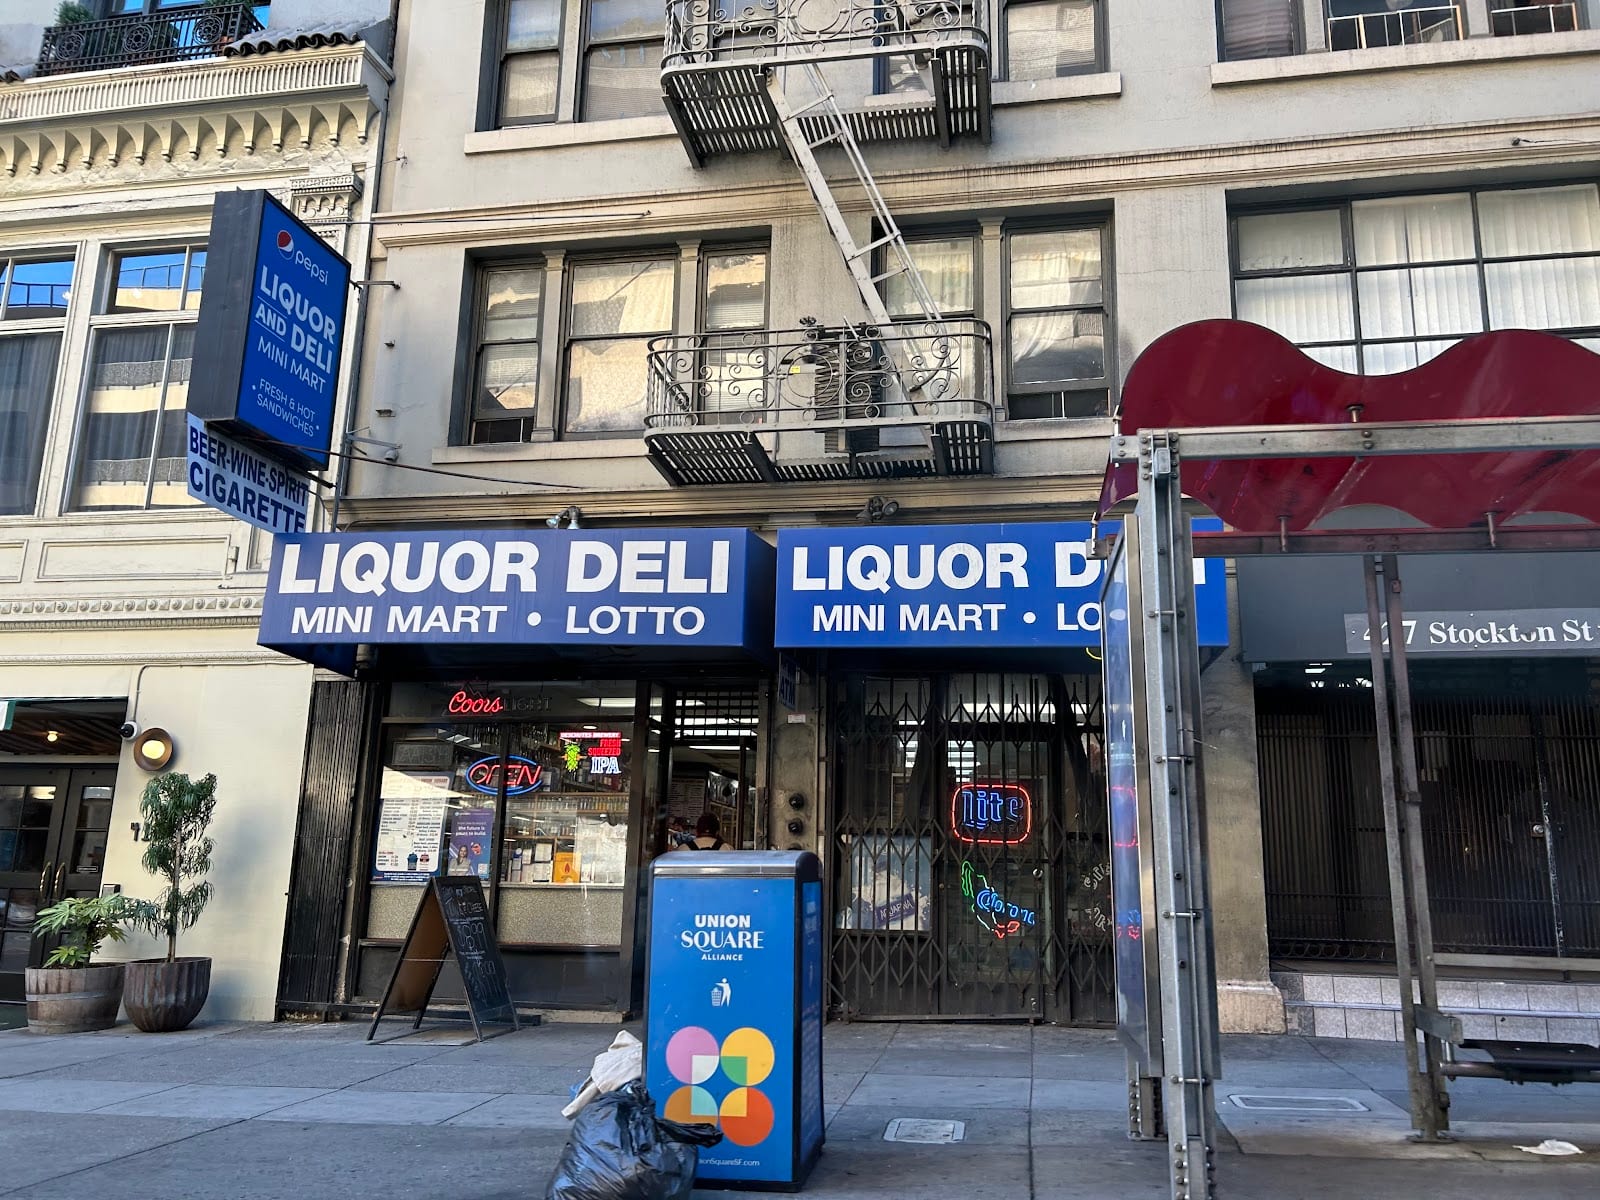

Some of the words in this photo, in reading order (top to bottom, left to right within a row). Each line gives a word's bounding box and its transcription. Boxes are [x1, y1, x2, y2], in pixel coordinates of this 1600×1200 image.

[295, 250, 329, 286] pepsi
[260, 265, 336, 345] LIQUOR
[255, 303, 287, 337] AND
[291, 323, 333, 374] DELI
[257, 335, 288, 370] MINI
[290, 358, 326, 394] MART
[259, 378, 288, 406] FRESH
[289, 397, 295, 410] &
[297, 401, 316, 422] HOT
[256, 395, 314, 438] SANDWICHES
[190, 461, 306, 533] CIGARETTE
[278, 540, 539, 597] LIQUOR
[566, 540, 730, 594] DELI
[792, 542, 1030, 594] LIQUOR
[290, 606, 373, 634] MINI
[387, 605, 508, 634] MART
[566, 606, 705, 635] LOTTO
[812, 604, 885, 632] MINI
[899, 603, 1006, 632] MART
[1429, 621, 1557, 645] Stockton
[1562, 619, 1594, 642] St
[448, 690, 504, 713] Coors
[588, 747, 621, 756] SQUEEZED
[600, 739, 621, 748] FRESH
[591, 756, 622, 774] IPA
[962, 790, 1024, 830] Lite
[695, 914, 751, 928] UNION
[880, 899, 914, 921] AQUAFNA
[681, 930, 765, 952] SQUARE
[701, 953, 744, 961] ALLIANCE
